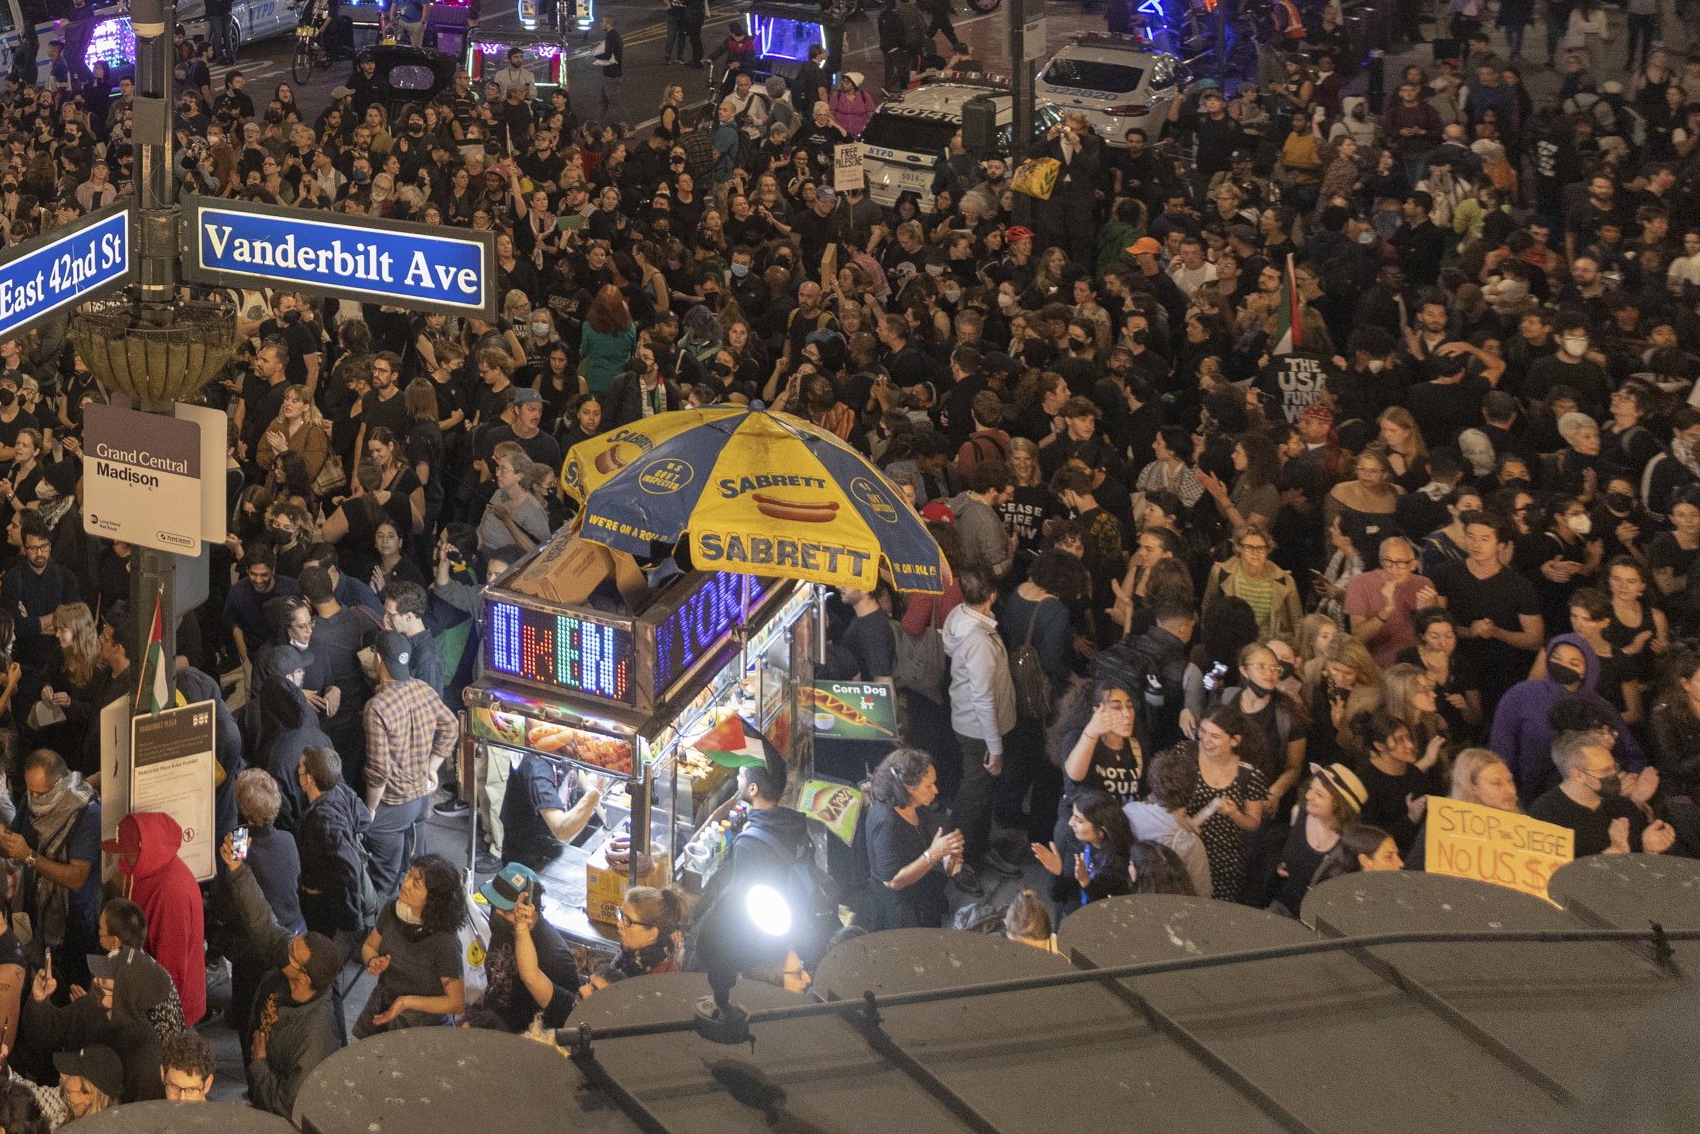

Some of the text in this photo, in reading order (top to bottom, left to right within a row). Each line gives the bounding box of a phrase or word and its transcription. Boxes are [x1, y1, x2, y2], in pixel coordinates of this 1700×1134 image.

[1046, 86, 1119, 102] 322820
[840, 146, 858, 158] FREE
[868, 146, 894, 159] NYPD
[49, 240, 97, 294] 42nd
[101, 232, 122, 270] St
[205, 223, 478, 294] Vanderbilt Ave
[1284, 357, 1322, 373] THE
[96, 443, 188, 474] Grand Central
[97, 461, 159, 488] Madison
[641, 474, 681, 490] INSPECTED
[717, 473, 828, 499] SABRETT
[999, 502, 1043, 517] CEASE
[588, 514, 617, 532] WE'RE
[619, 523, 631, 536] ON
[632, 527, 639, 539] A
[1004, 513, 1033, 526] FIRE
[696, 528, 871, 578] SABRETT
[832, 684, 887, 697] Corn Dog
[860, 702, 874, 710] NY
[138, 767, 159, 776] Pedestrian
[1095, 764, 1127, 780] NOT
[1103, 780, 1139, 795] OUR
[1438, 805, 1500, 841] STOP
[1512, 824, 1567, 858] SIEGE
[1438, 840, 1472, 873] NO
[600, 903, 617, 912] COR
